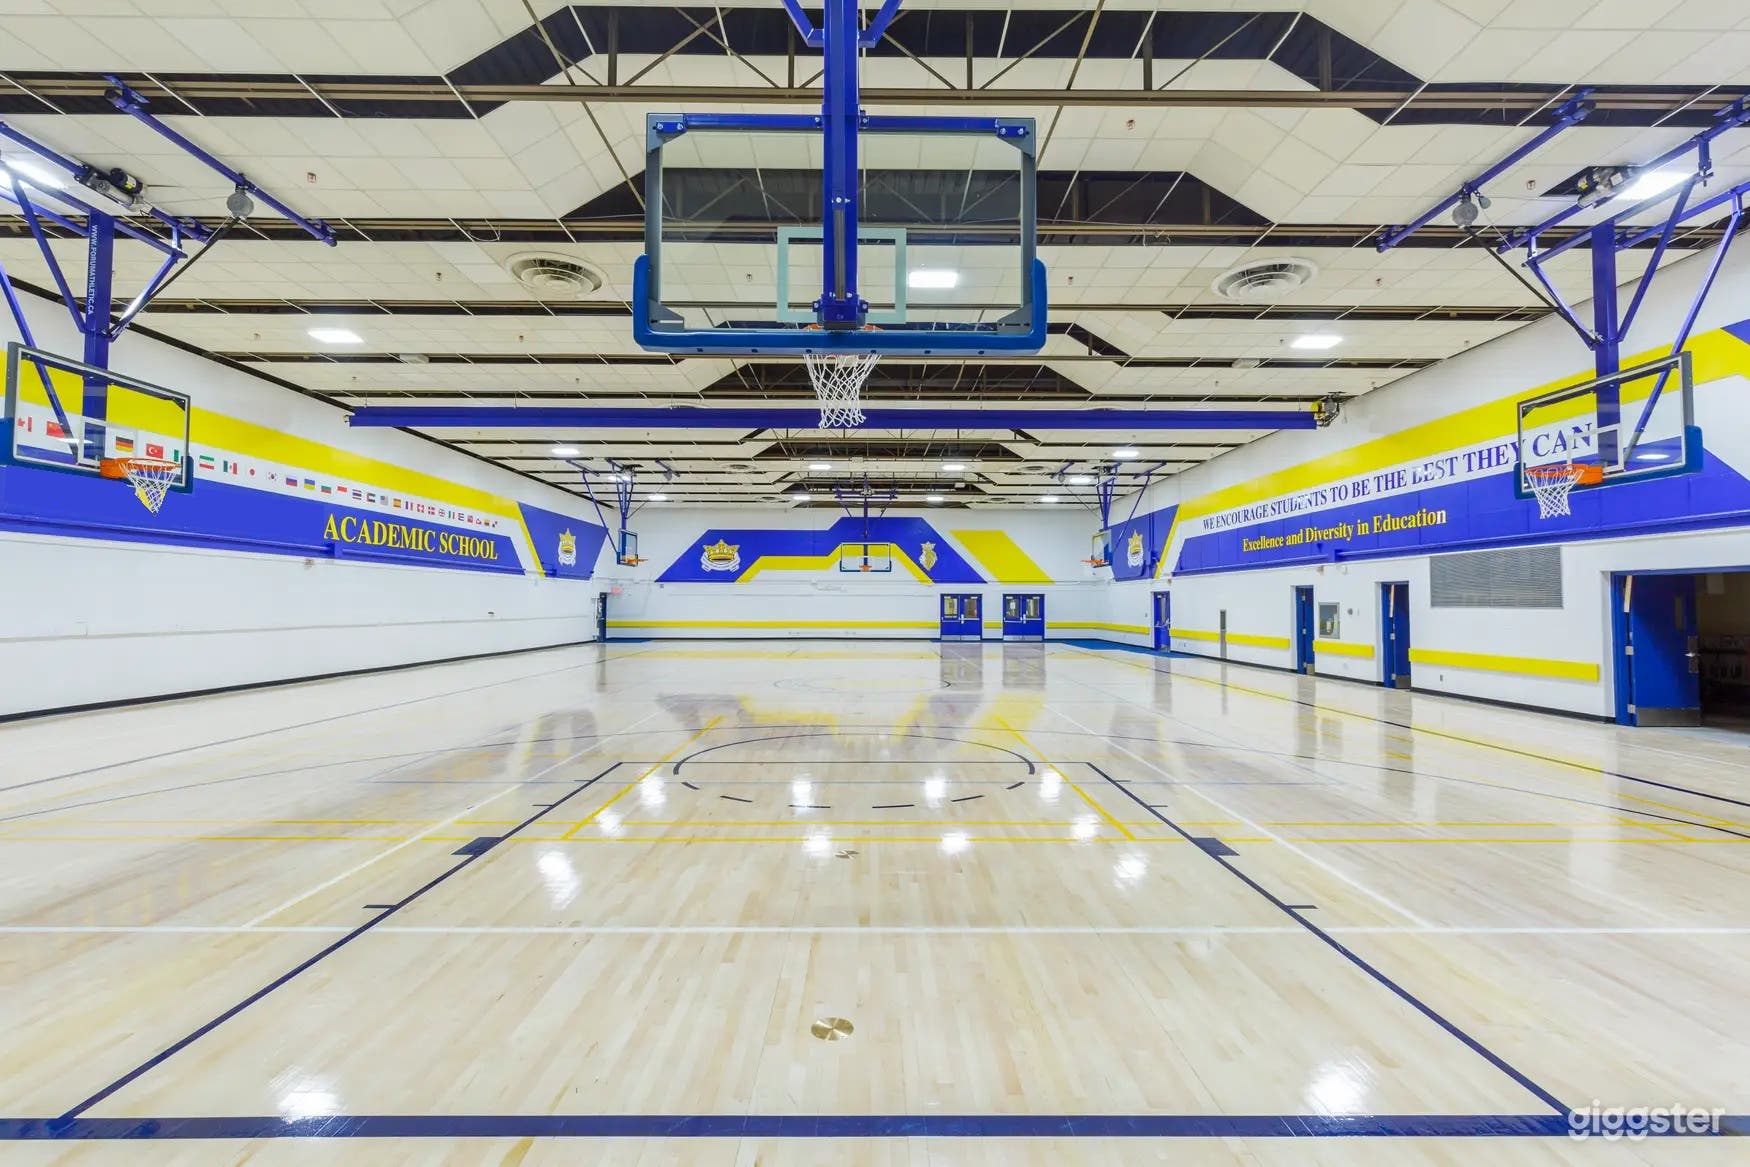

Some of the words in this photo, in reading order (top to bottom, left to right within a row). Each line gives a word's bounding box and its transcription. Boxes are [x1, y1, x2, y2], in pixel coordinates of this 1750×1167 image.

[88, 224, 98, 315] WWW.FORUMATHLETIC.CA
[1203, 517, 1214, 531] WE
[1215, 503, 1269, 528] ENCOURAGE
[1329, 484, 1348, 503] TO
[1351, 479, 1371, 498] BE
[1373, 468, 1407, 492] THE
[1463, 439, 1527, 470] THEY
[1532, 423, 1593, 457] CAN
[324, 513, 436, 553] ACADEMIC
[439, 531, 498, 560] SCHOOL
[1242, 535, 1284, 552] Excellence
[1286, 529, 1304, 546] and
[1305, 521, 1354, 543] Diversity
[1357, 520, 1370, 534] in
[1373, 507, 1447, 533] Education
